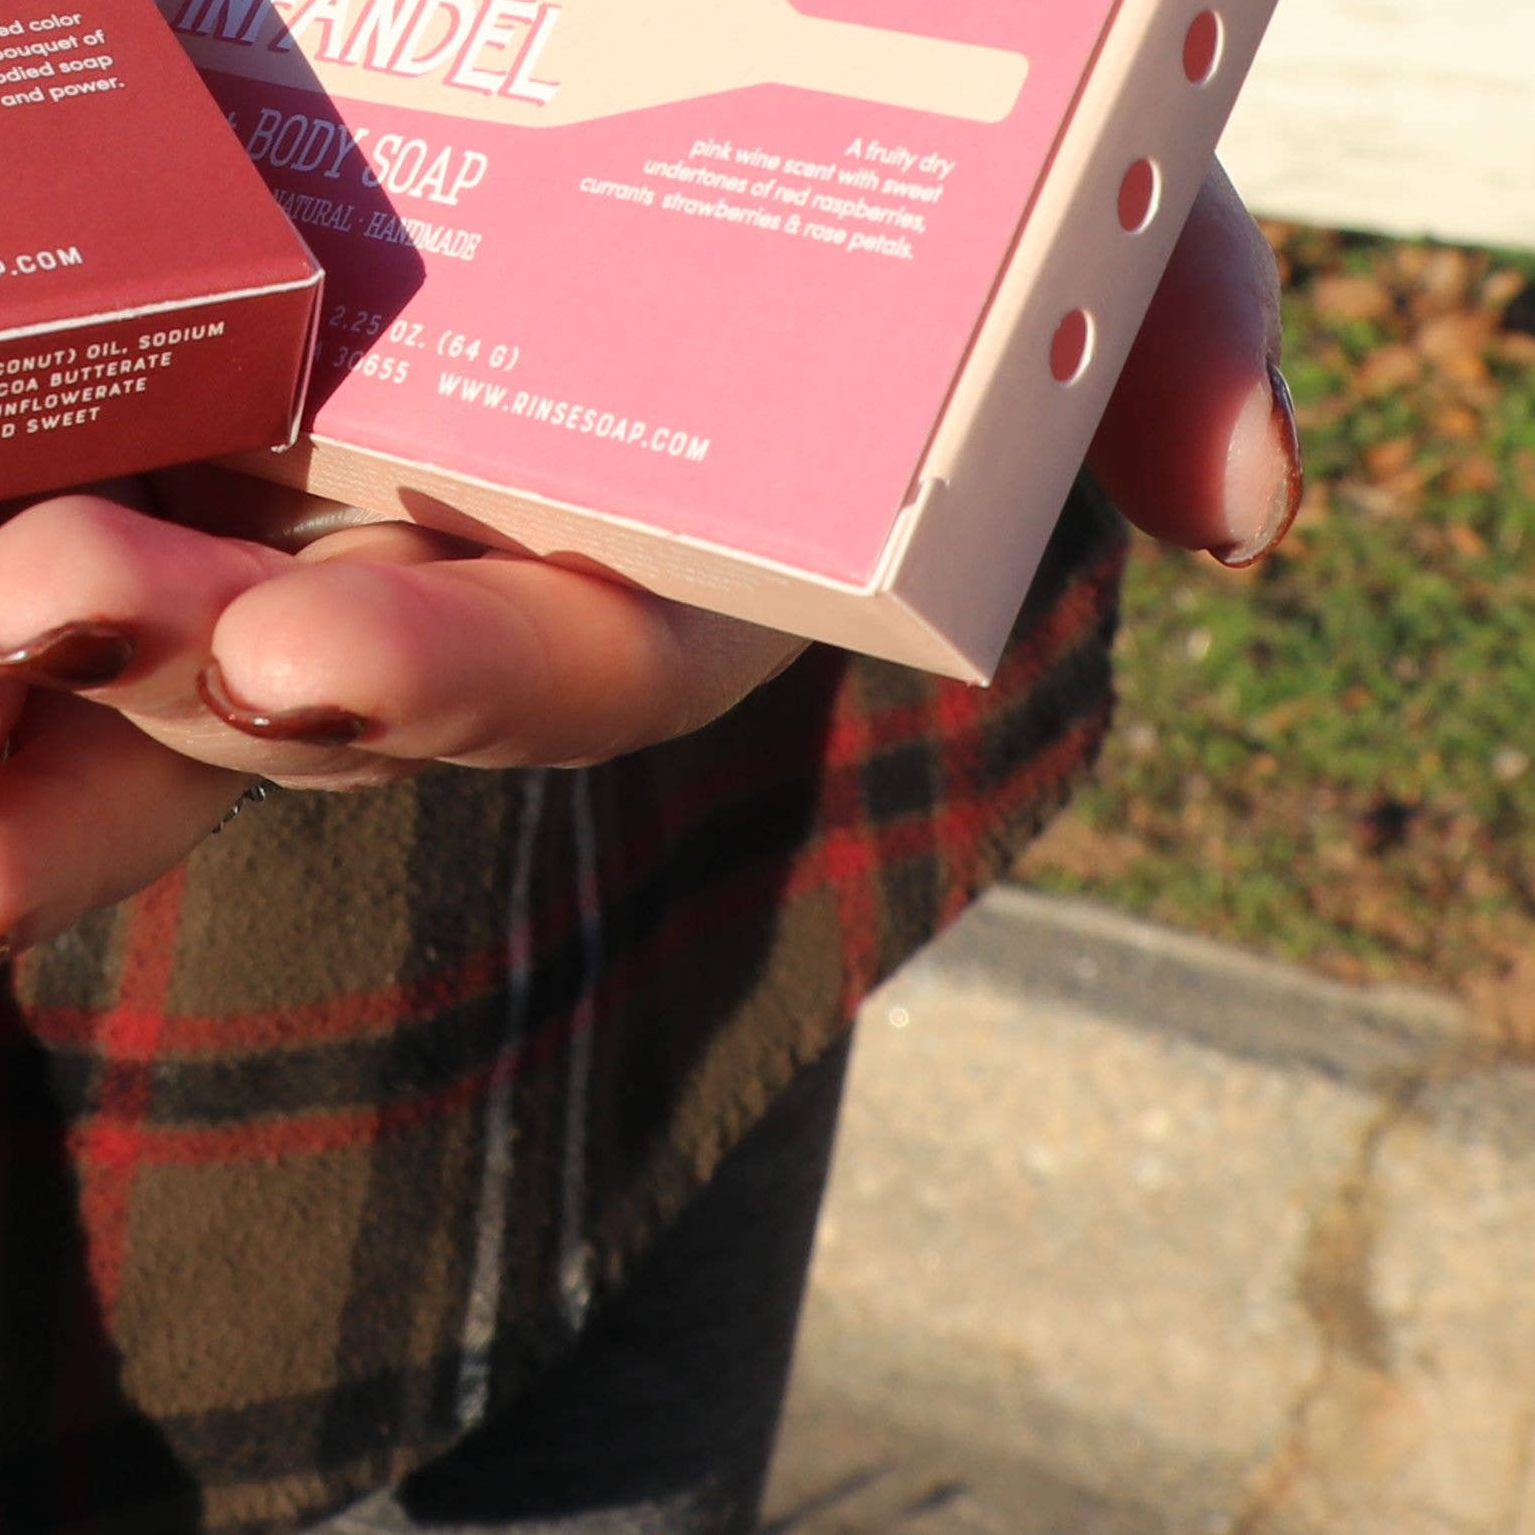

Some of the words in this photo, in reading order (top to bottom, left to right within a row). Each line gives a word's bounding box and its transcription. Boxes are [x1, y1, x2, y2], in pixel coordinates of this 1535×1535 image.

[29, 14, 81, 31] color
[82, 29, 105, 45] of
[58, 56, 113, 73] soap
[1, 86, 45, 106] and
[48, 77, 125, 102] power.
[248, 108, 368, 179] BODY
[362, 128, 488, 206] SOAP
[688, 138, 733, 162] pink
[735, 147, 781, 170] wine
[782, 160, 837, 181] scent
[837, 168, 879, 191] with
[881, 179, 944, 203] sweet
[865, 140, 919, 174] fruity
[919, 152, 956, 181] dry
[643, 159, 750, 193] undertones
[774, 185, 812, 208] red
[364, 211, 482, 261] HANDMADE
[579, 177, 655, 205] currants
[661, 192, 782, 230] strawberries
[803, 222, 847, 243] rose
[845, 232, 914, 260] petals.
[139, 321, 225, 350] SODIUM
[390, 320, 425, 349] OZ.
[436, 329, 480, 362] (64
[489, 344, 519, 371] G)
[50, 351, 172, 387] BUTTERATE
[333, 344, 408, 383] 30655
[27, 406, 100, 433] SWEET
[438, 372, 711, 461] WWW.RINSESOAP.COM
